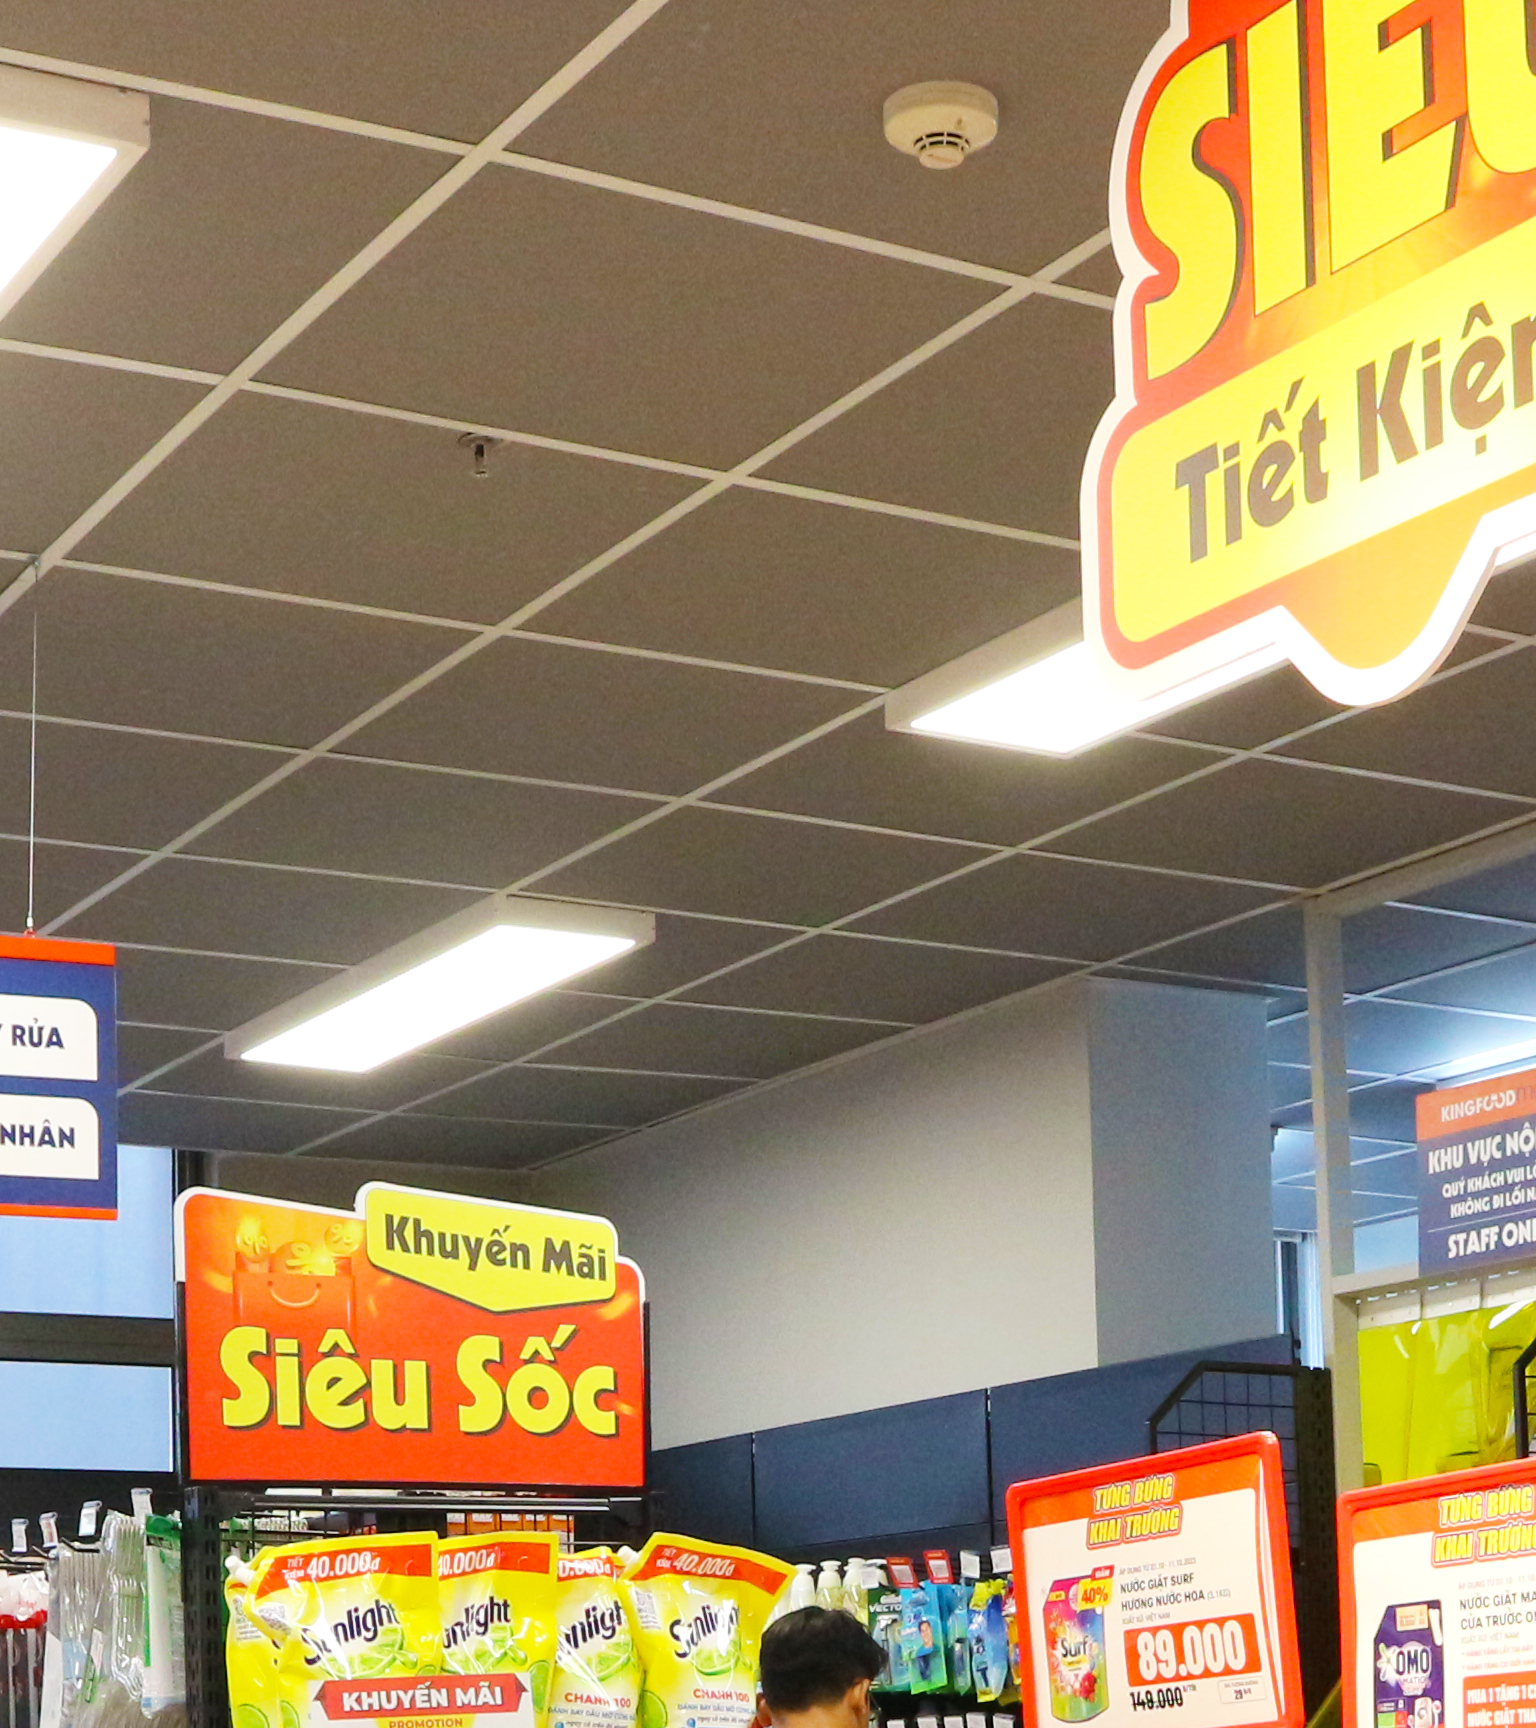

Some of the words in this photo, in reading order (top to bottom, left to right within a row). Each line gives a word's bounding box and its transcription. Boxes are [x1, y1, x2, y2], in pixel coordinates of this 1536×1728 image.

[1175, 377, 1328, 564] Tiết
[11, 1015, 64, 1050] RỬA
[0, 1112, 76, 1150] NHÂN
[1428, 1144, 1463, 1175] KHU
[1467, 1135, 1502, 1166] VỰC
[1442, 1175, 1465, 1198] QUÝ
[1468, 1168, 1504, 1193] KHÁCH
[1506, 1167, 1525, 1187] VUI
[1450, 1193, 1490, 1218] KHÔNG
[1492, 1193, 1504, 1210] ĐI
[1506, 1186, 1524, 1206] LỐI
[385, 1213, 530, 1272] Khuyến
[542, 1238, 608, 1281] Mãi
[1448, 1226, 1498, 1258] STAFF
[219, 1325, 430, 1430] Siêu
[456, 1324, 617, 1437] Sốc
[1120, 1578, 1146, 1594] NƯỚC
[1148, 1575, 1168, 1592] GIẶT
[1171, 1573, 1195, 1587] SURF
[1137, 1619, 1247, 1681] 89.000
[343, 1682, 451, 1712] KHUYẾN
[456, 1682, 502, 1708] MÃI
